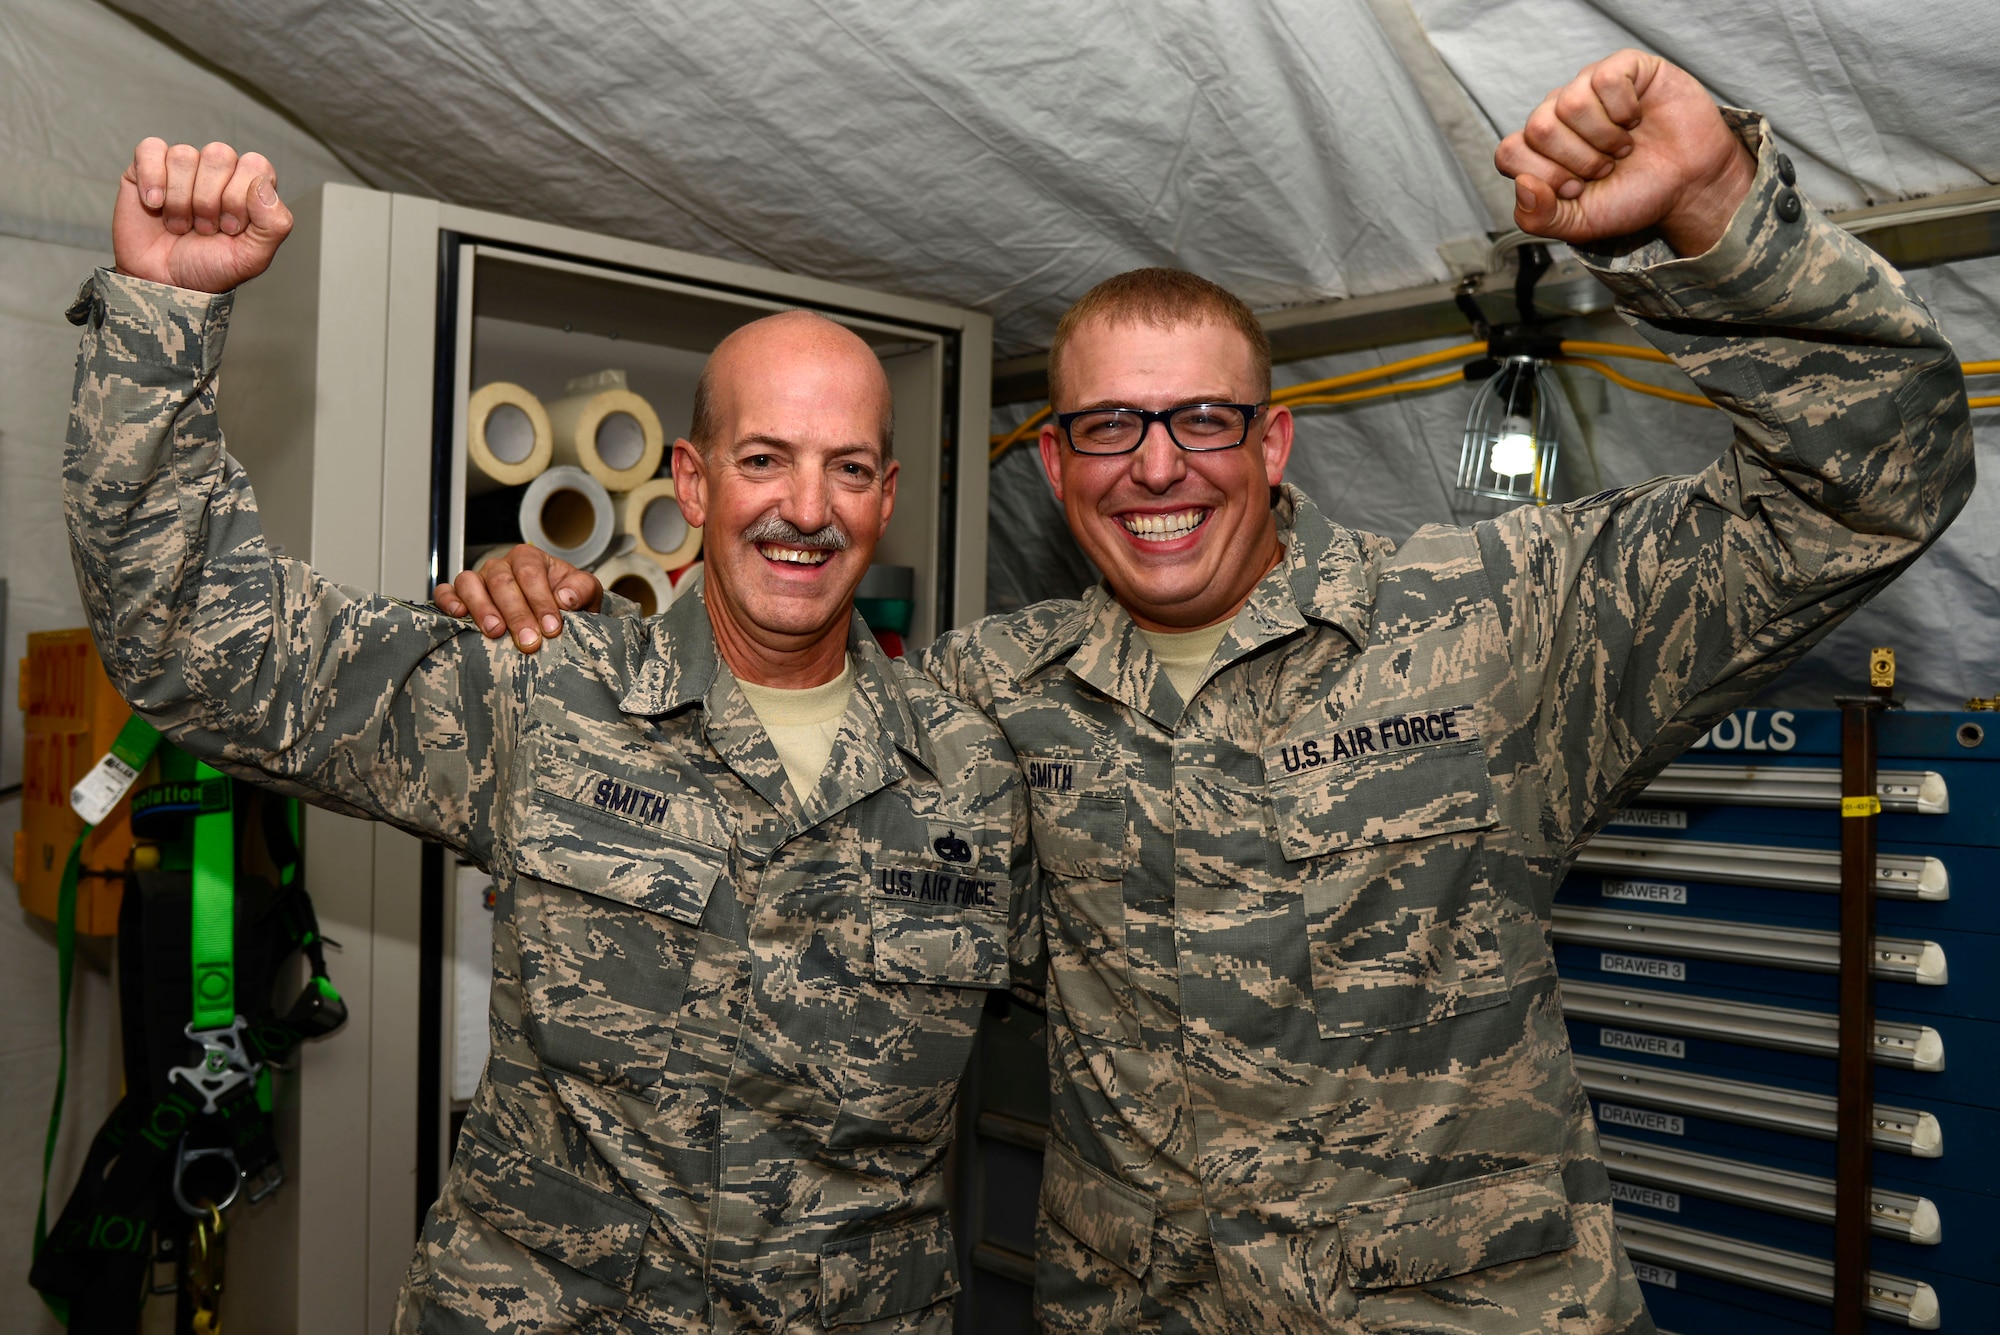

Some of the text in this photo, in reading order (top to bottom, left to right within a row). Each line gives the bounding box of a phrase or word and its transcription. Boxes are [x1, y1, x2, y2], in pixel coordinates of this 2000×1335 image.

[1281, 711, 1459, 773] U.S. AIR FORCE
[1690, 710, 1796, 752] OLS
[1030, 762, 1073, 790] SMITH
[132, 784, 203, 812] volution
[594, 779, 670, 823] SMITH
[1612, 810, 1681, 826] RAWER 1
[882, 868, 997, 906] U.S. AIR FORCE
[1604, 882, 1682, 901] DRAWER 2
[1604, 956, 1681, 978] DRAWER 3
[1604, 1031, 1680, 1055] DRAWER 4
[1602, 1106, 1680, 1132] DRAWER 5
[1610, 1184, 1675, 1209] RAWER 6
[1663, 1271, 1672, 1284] 7
